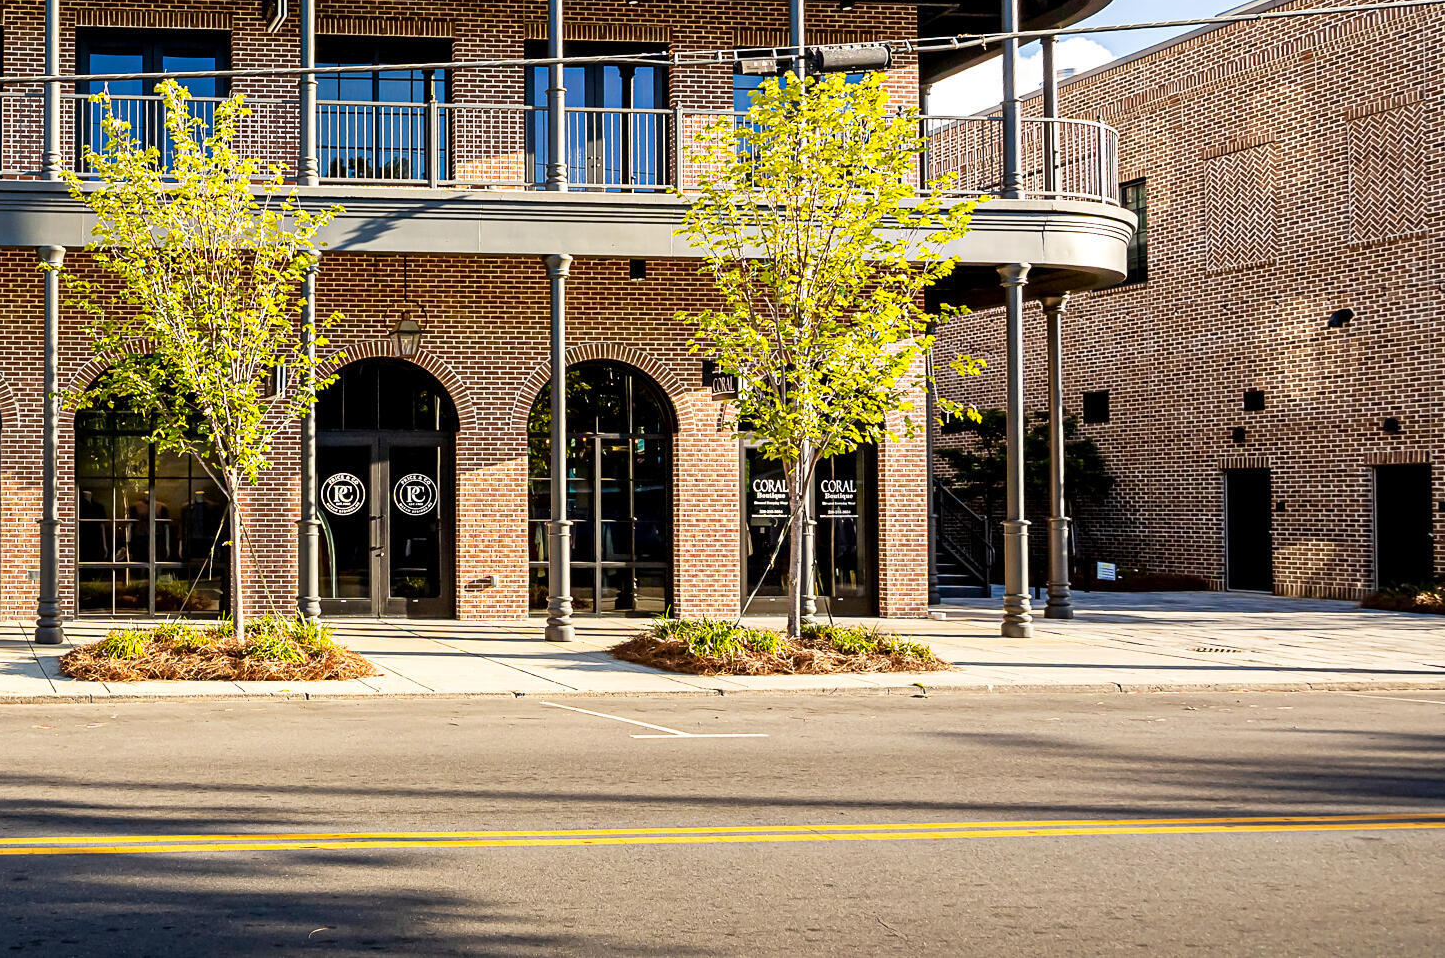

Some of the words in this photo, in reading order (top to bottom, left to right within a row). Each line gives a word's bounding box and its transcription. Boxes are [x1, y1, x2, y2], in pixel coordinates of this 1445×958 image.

[712, 376, 735, 393] CORAL
[328, 474, 345, 485] PRICE
[351, 477, 360, 485] CO
[400, 475, 417, 485] PRICE
[423, 477, 431, 485] CO
[753, 479, 789, 493] CORAL
[821, 479, 857, 493] CORAL
[756, 492, 786, 500] Boutique
[824, 493, 854, 501] Boutique
